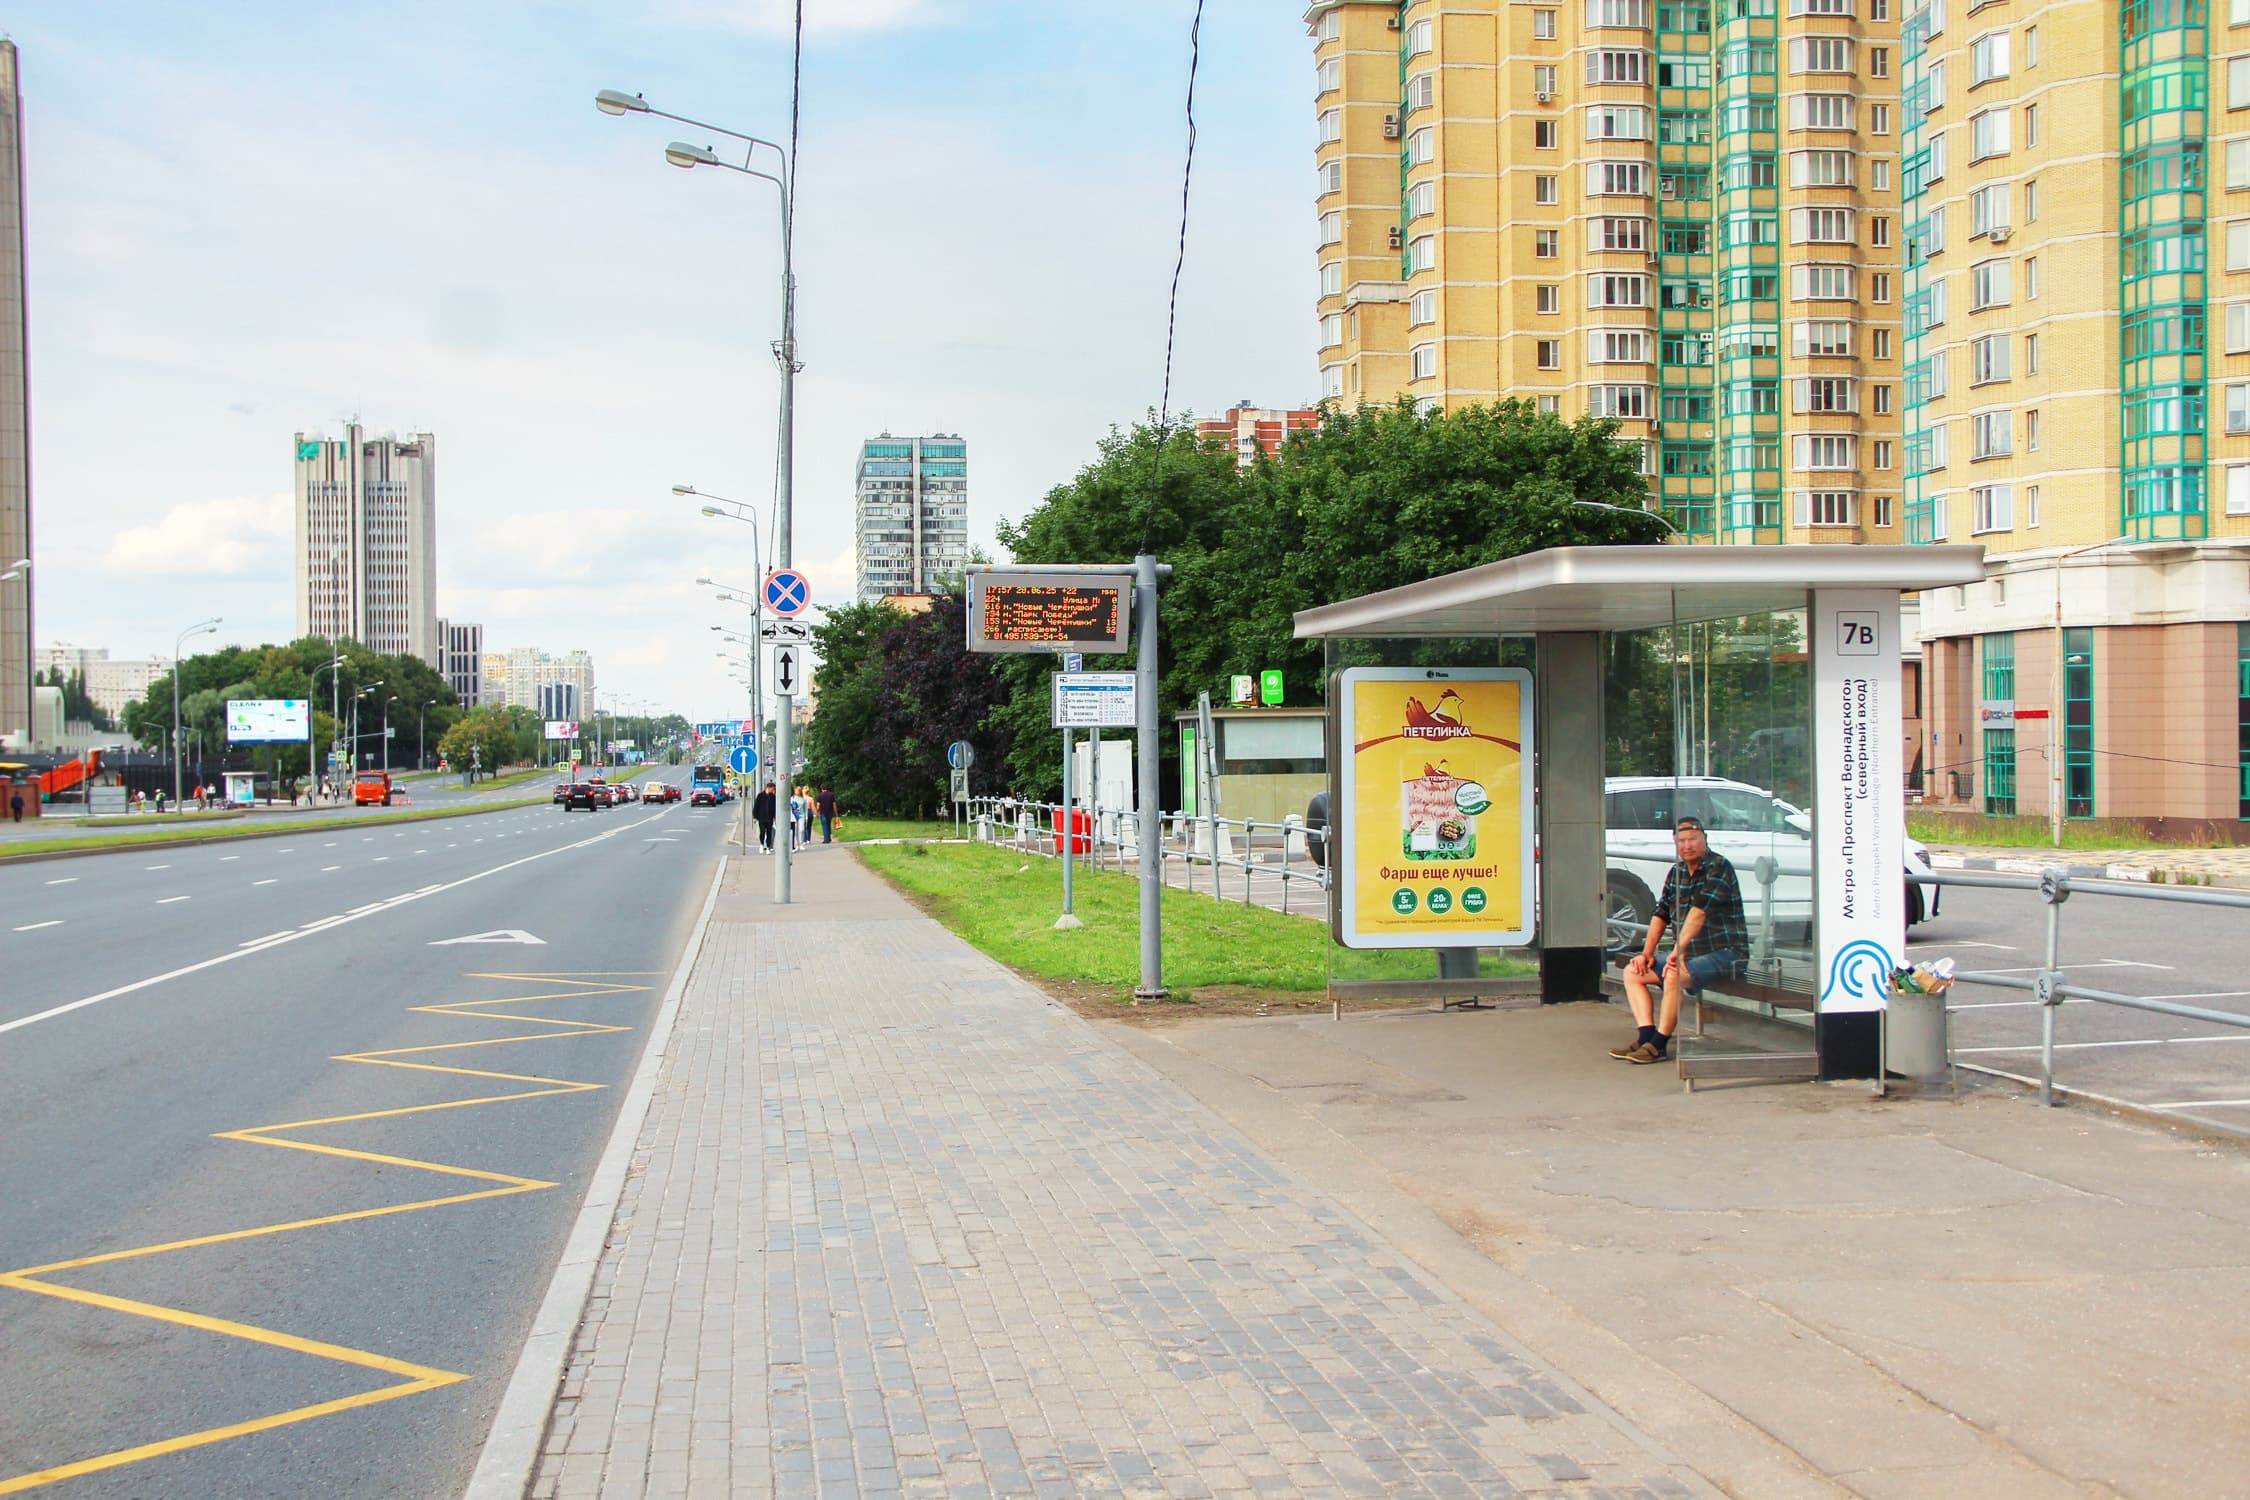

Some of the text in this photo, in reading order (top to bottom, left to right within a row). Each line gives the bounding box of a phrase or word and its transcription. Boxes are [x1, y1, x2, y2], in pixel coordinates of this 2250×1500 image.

[986, 586, 1012, 595] 17:57
[1061, 587, 1078, 595] +22
[984, 595, 1001, 604] 224
[984, 602, 1001, 611] 616
[984, 617, 1001, 625] 153
[984, 625, 1000, 633] 266
[1403, 726, 1472, 737] ПЕТЕЛИНКА
[1854, 678, 1869, 800] (северный вход)
[1841, 679, 1856, 919] Метро «Проспект Вернадского»
[1380, 864, 1498, 882] Фарш еще лучше!
